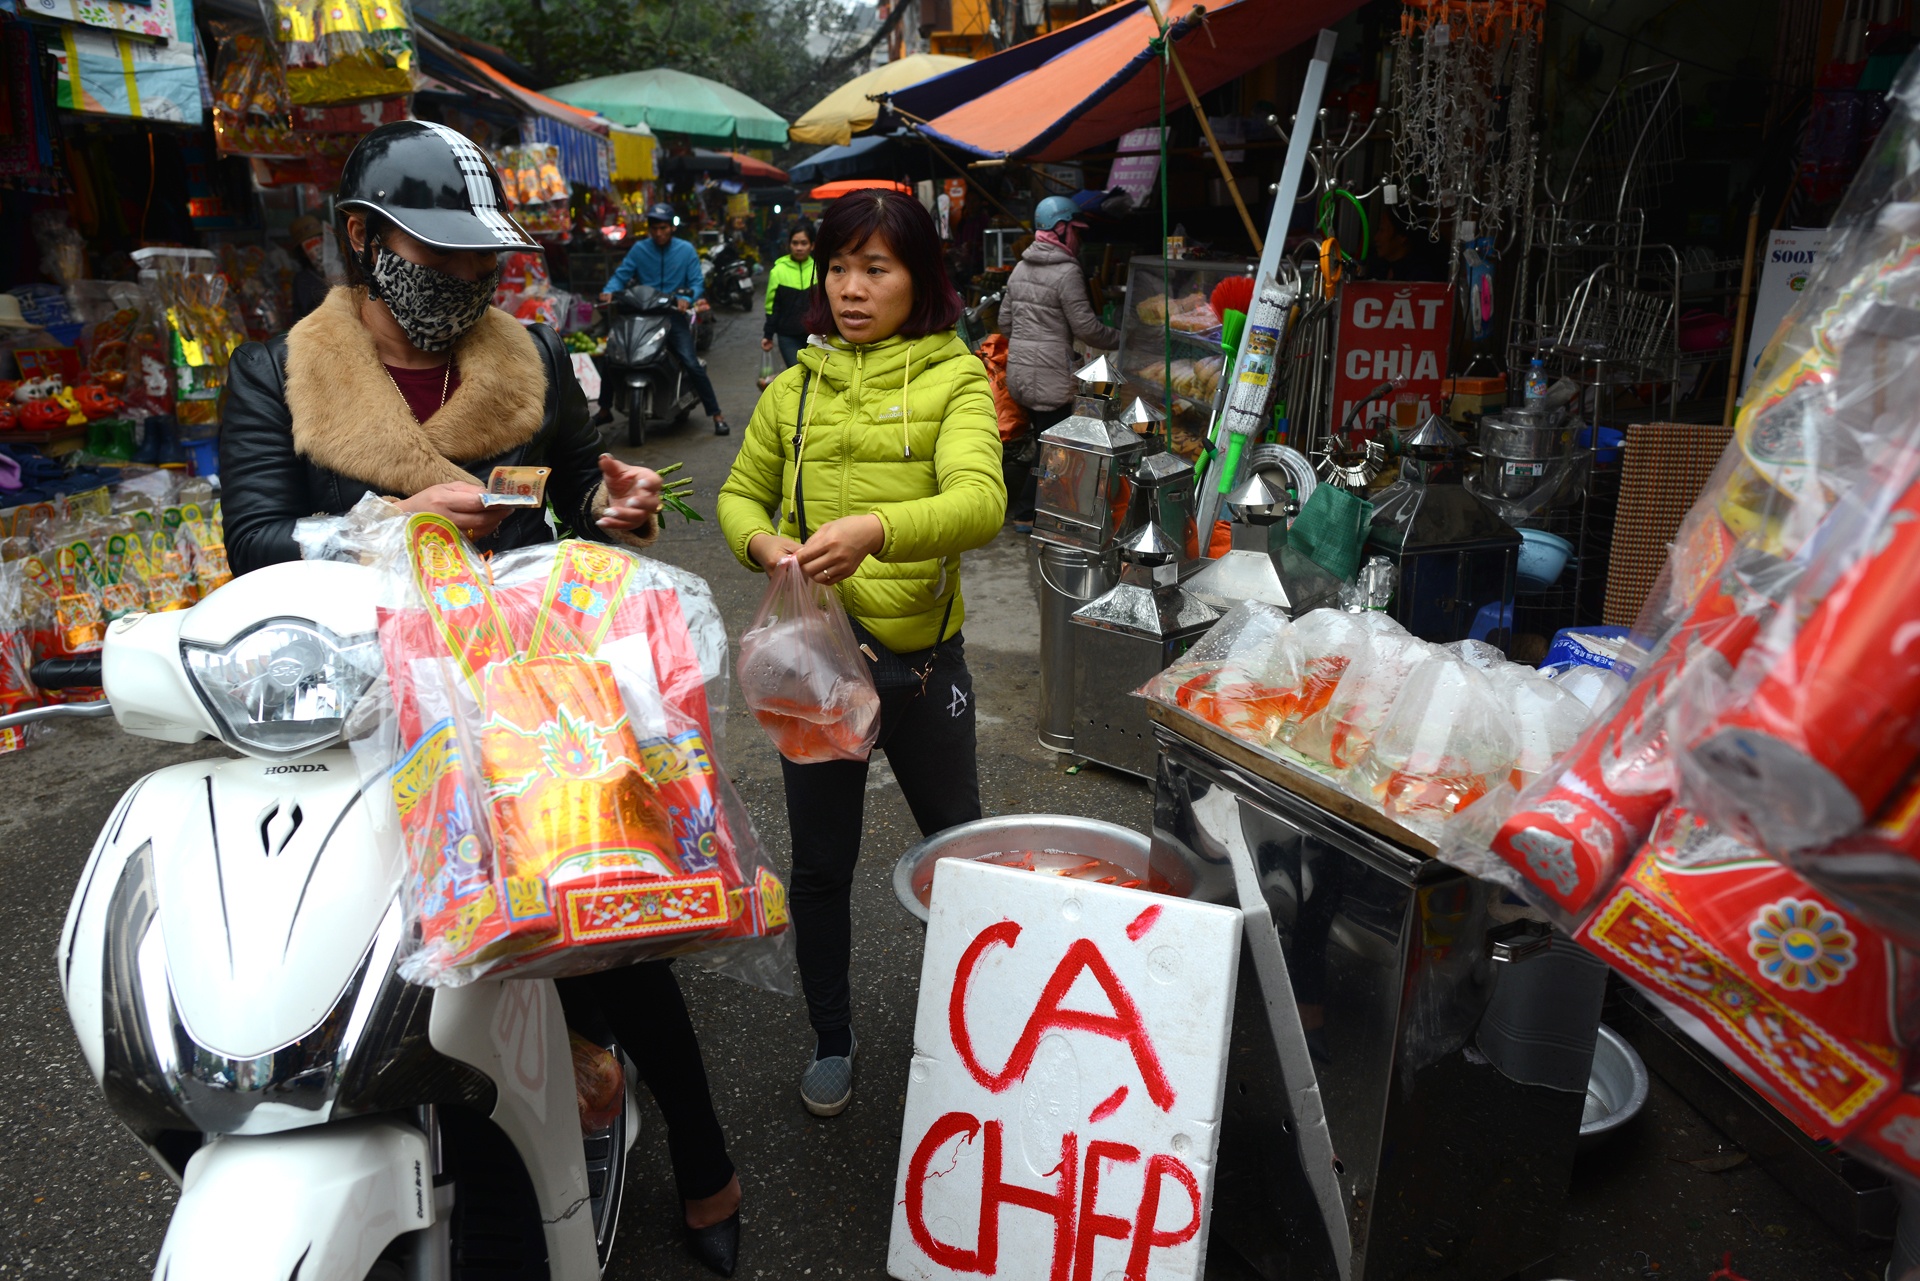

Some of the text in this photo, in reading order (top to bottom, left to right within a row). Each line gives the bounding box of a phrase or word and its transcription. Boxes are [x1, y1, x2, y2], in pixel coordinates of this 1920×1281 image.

[1352, 287, 1444, 330] CẮT
[1344, 343, 1440, 381] CHÌA
[264, 763, 330, 776] HONDA
[949, 904, 1177, 1113] CÁ
[414, 1160, 424, 1219] Combi Brake
